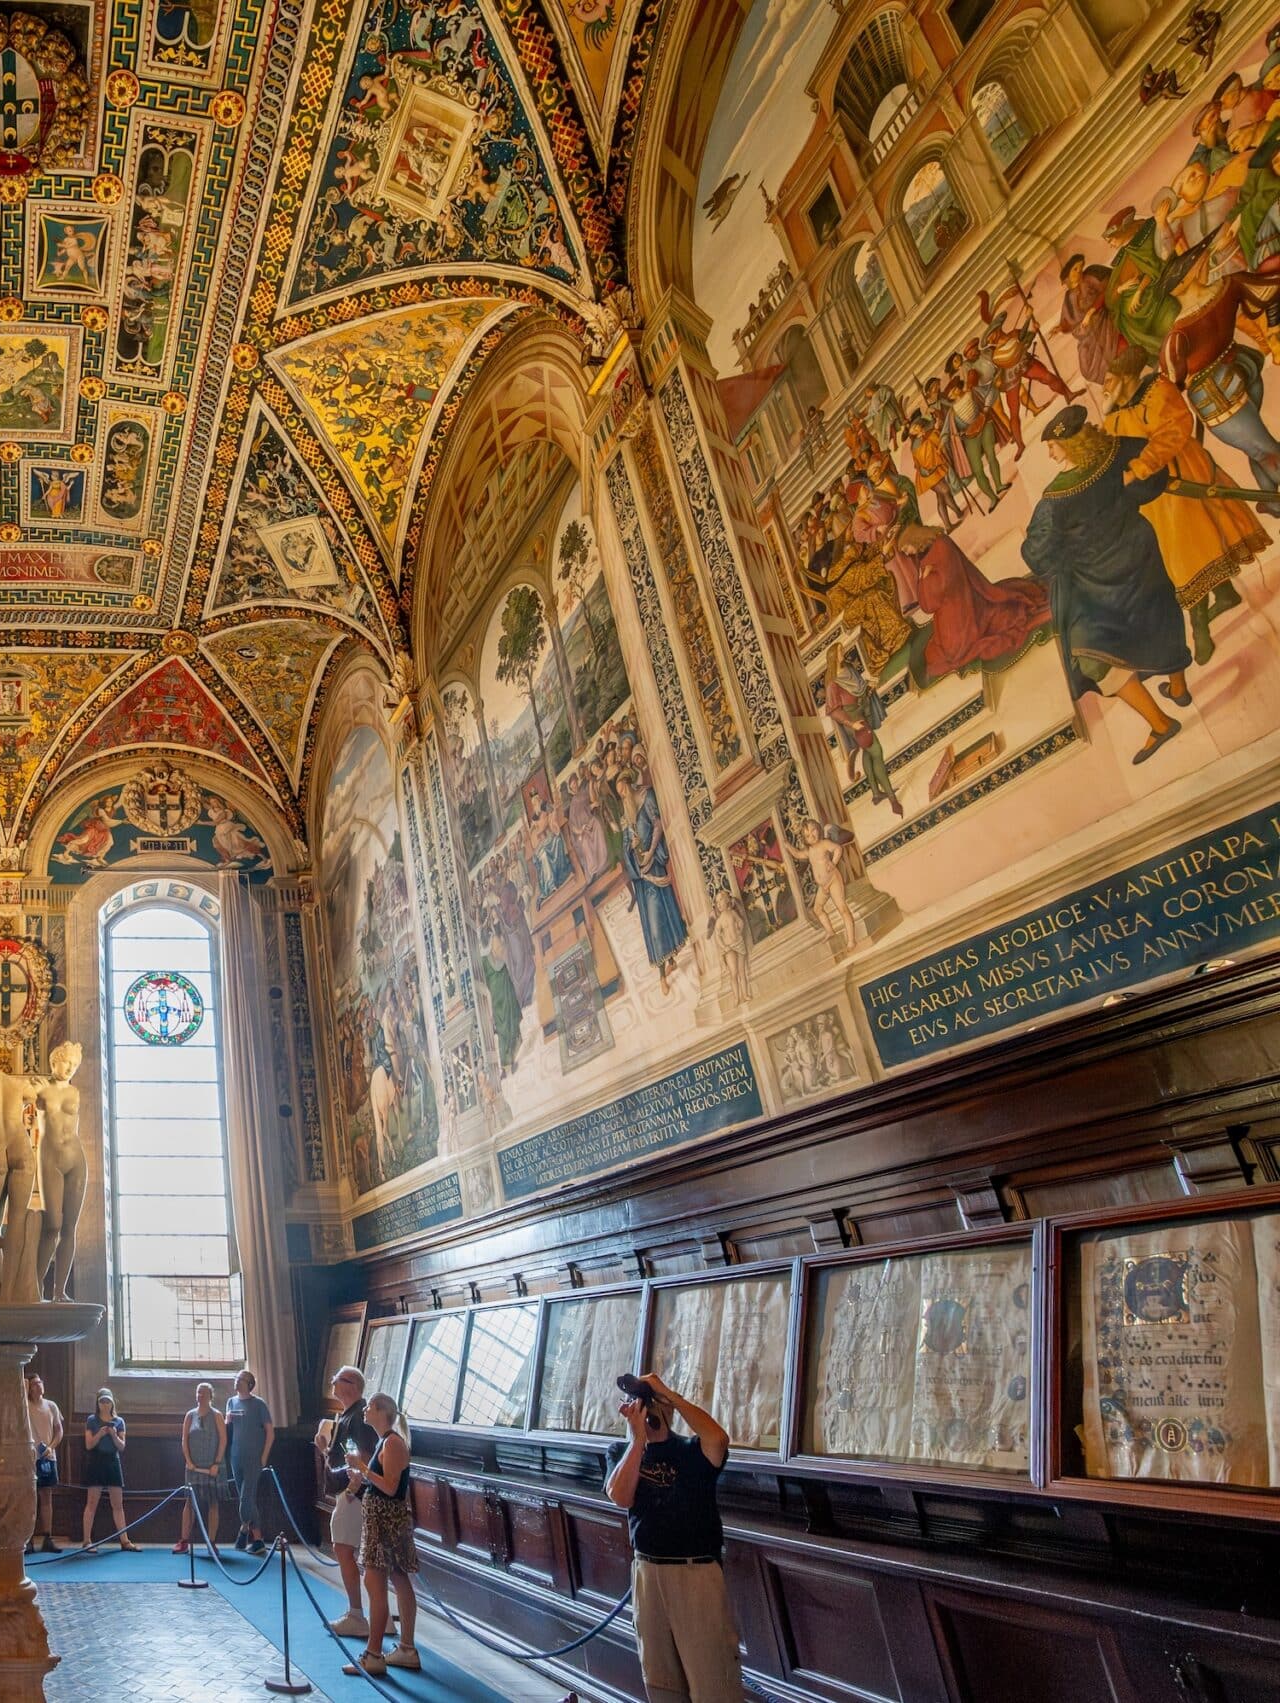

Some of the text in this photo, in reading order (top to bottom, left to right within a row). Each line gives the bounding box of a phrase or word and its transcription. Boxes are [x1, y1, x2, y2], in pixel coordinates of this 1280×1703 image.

[870, 982, 902, 1007] HIC
[909, 948, 979, 992] AENEAS
[1124, 831, 1267, 903] ANTIPAPA
[878, 856, 1280, 1030] CAESAREM MISSVS LAVREA CORON
[908, 1018, 948, 1045] EIVS
[954, 1007, 980, 1030] AC
[983, 951, 1131, 1018] SECRETARIVS
[678, 1078, 713, 1103] MISSVS
[693, 1049, 743, 1081] BRITANNI
